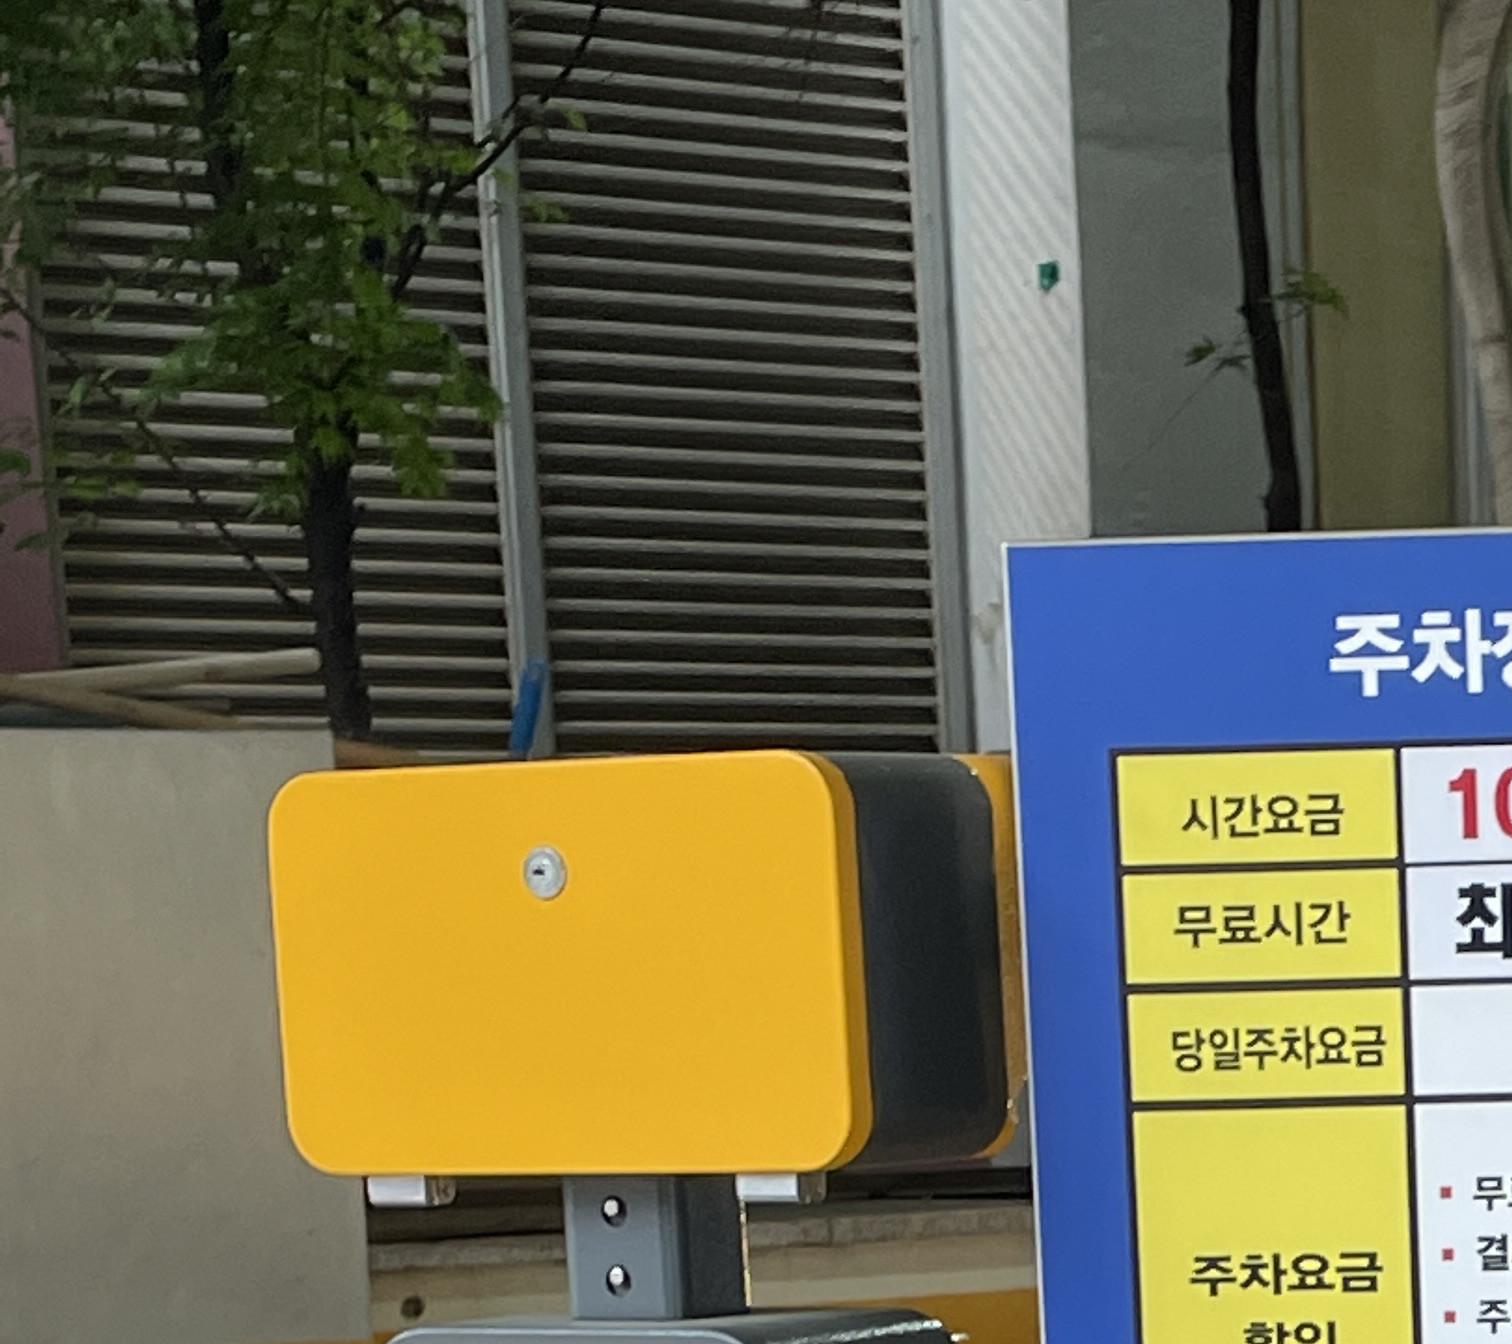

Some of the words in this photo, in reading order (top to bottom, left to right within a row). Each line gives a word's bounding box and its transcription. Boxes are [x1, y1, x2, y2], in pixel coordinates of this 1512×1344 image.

[1183, 795, 1343, 838] 시간요금
[1175, 901, 1350, 947] 무료시간
[1173, 1026, 1386, 1072] 당일주차요금
[1191, 1253, 1382, 1296] 주차요금
